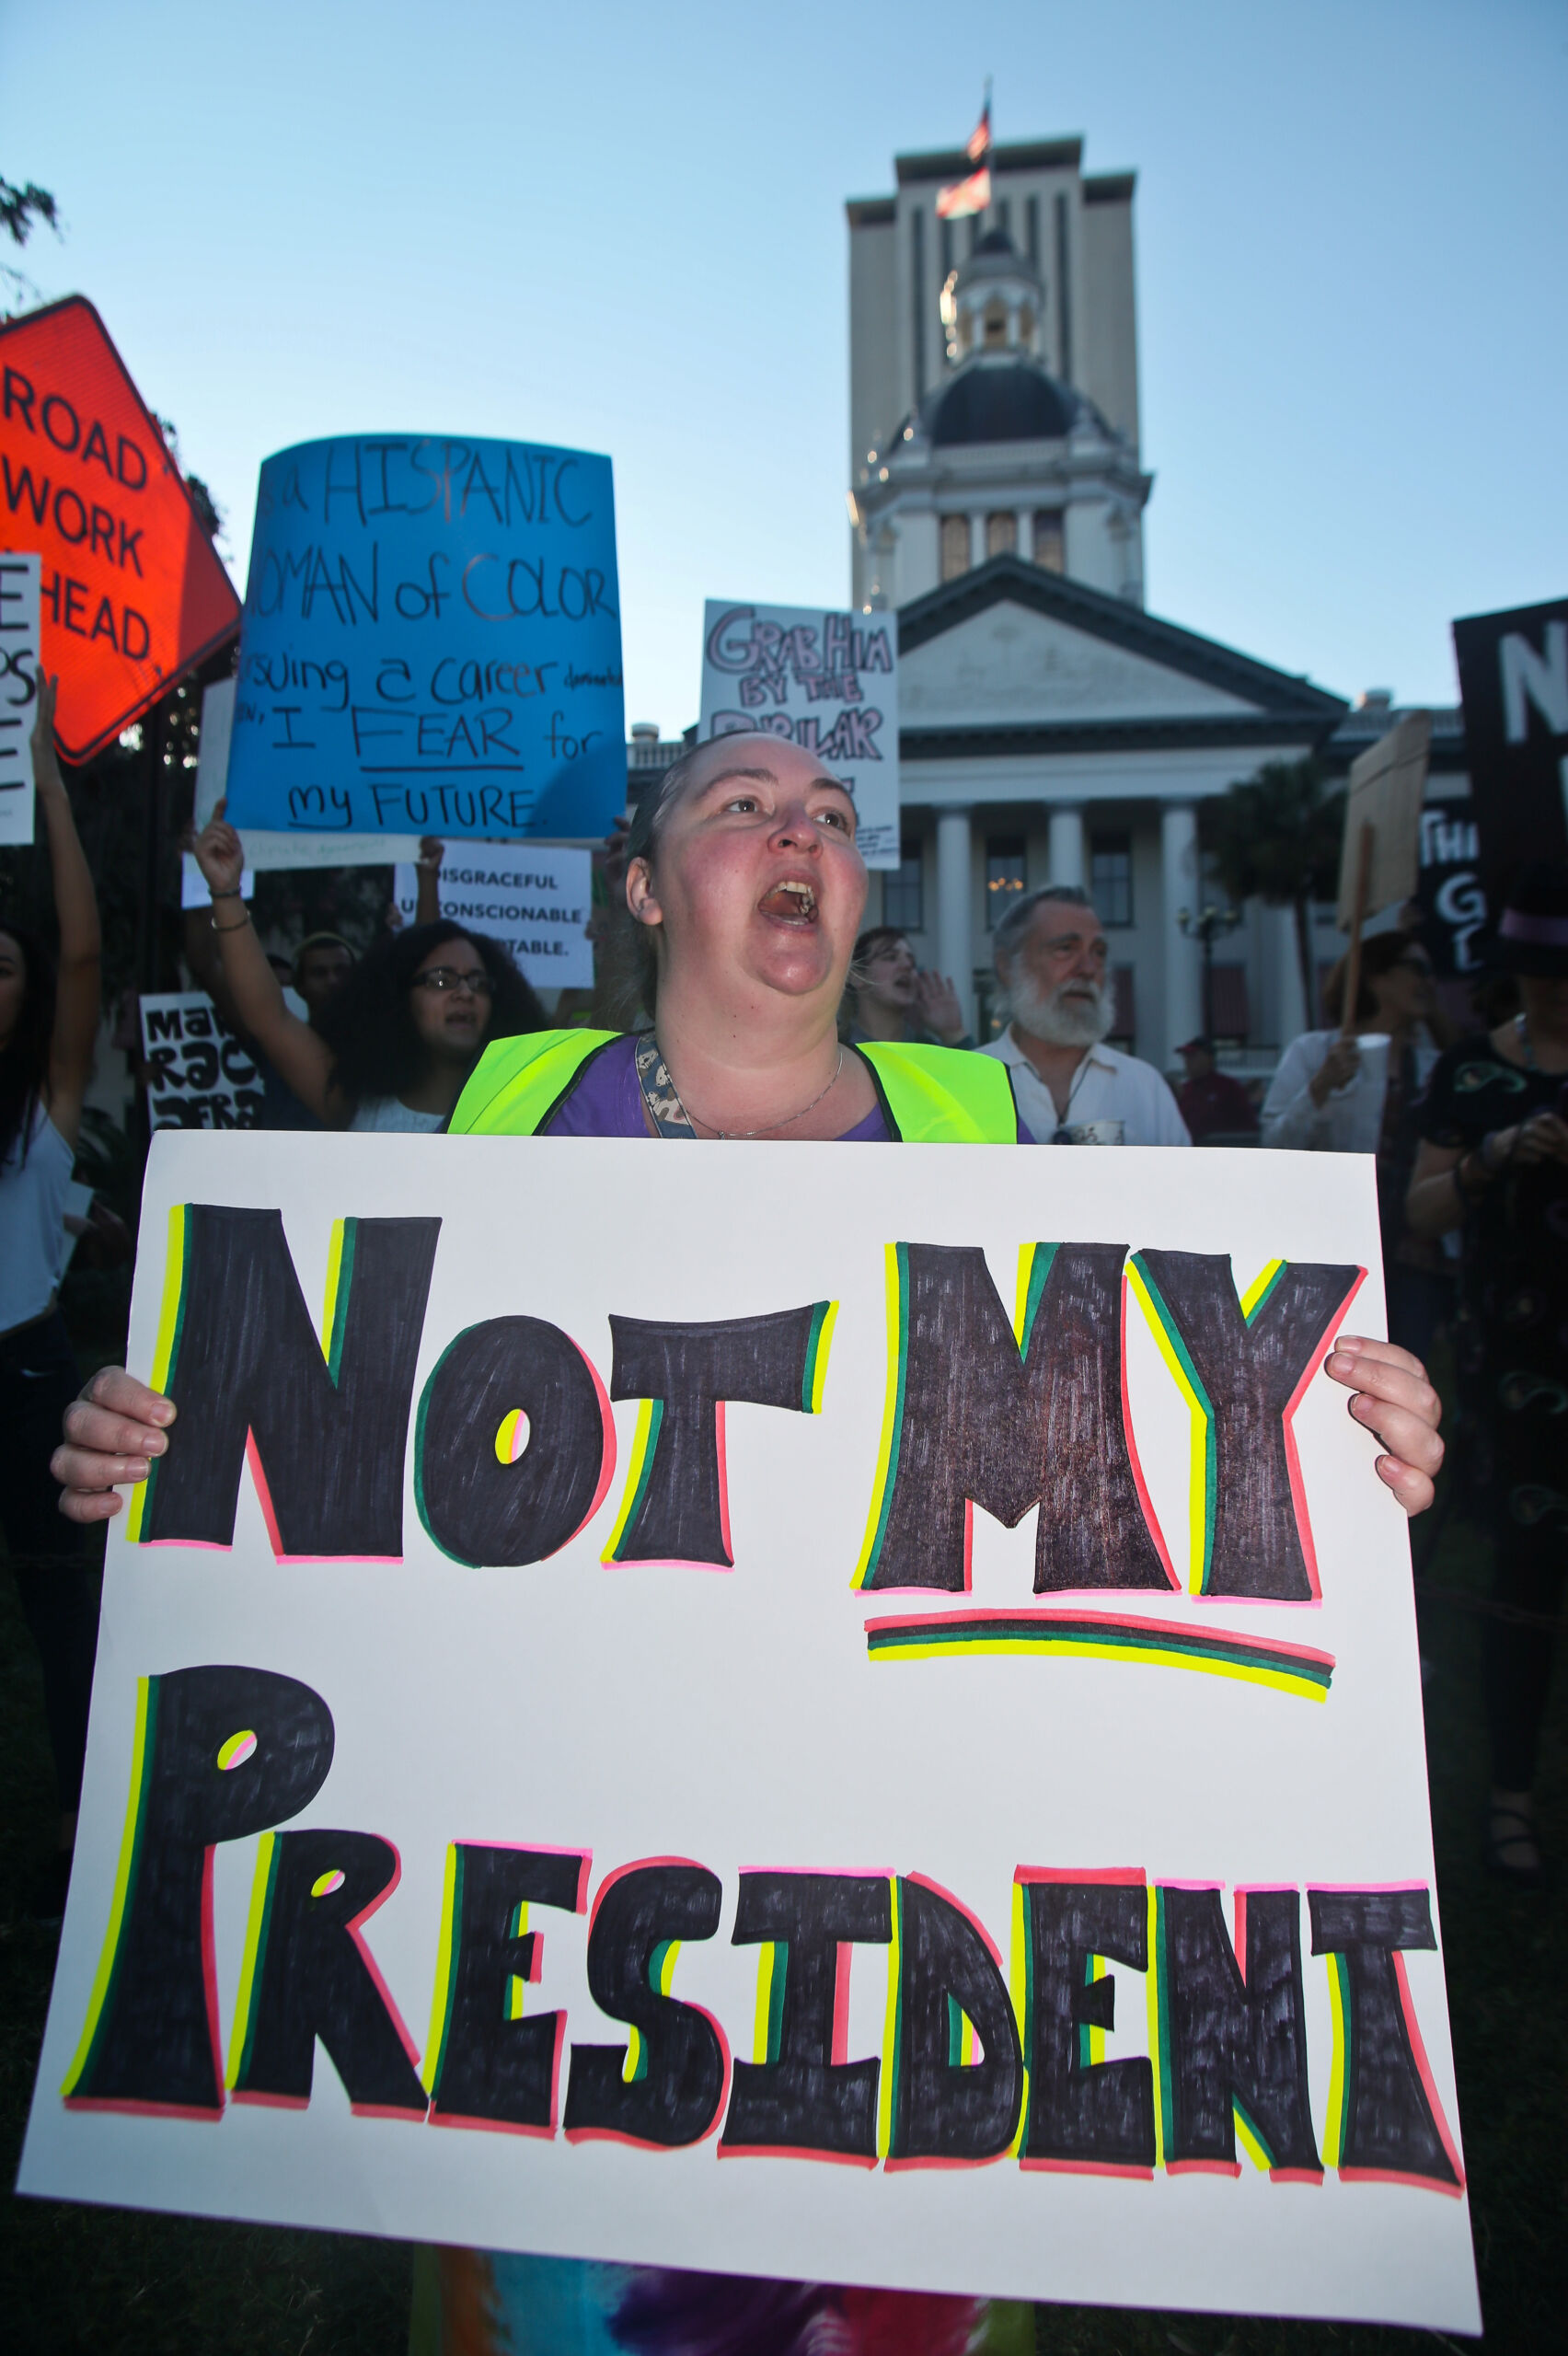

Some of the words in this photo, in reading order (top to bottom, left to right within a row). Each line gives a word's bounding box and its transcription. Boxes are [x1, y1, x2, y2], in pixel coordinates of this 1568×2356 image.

[4, 366, 147, 491] ROAD
[1, 454, 144, 579] WORK
[323, 438, 594, 527] HISPANIC
[40, 570, 150, 662] HEAD
[394, 552, 451, 620] of
[706, 606, 821, 675] GRAB
[824, 612, 893, 673] HIM
[376, 659, 416, 703] a
[430, 658, 559, 706] career
[739, 673, 787, 707] BY
[795, 671, 863, 704] THE
[272, 706, 317, 749] I
[351, 706, 521, 758] FEAR
[544, 710, 604, 760] for
[710, 707, 883, 761] PPULAR
[441, 868, 560, 891] ISGRACEFUL
[126, 1203, 840, 1572] NOT
[850, 1242, 1368, 1609] MY
[61, 1664, 1466, 2199] PRESIDENT
